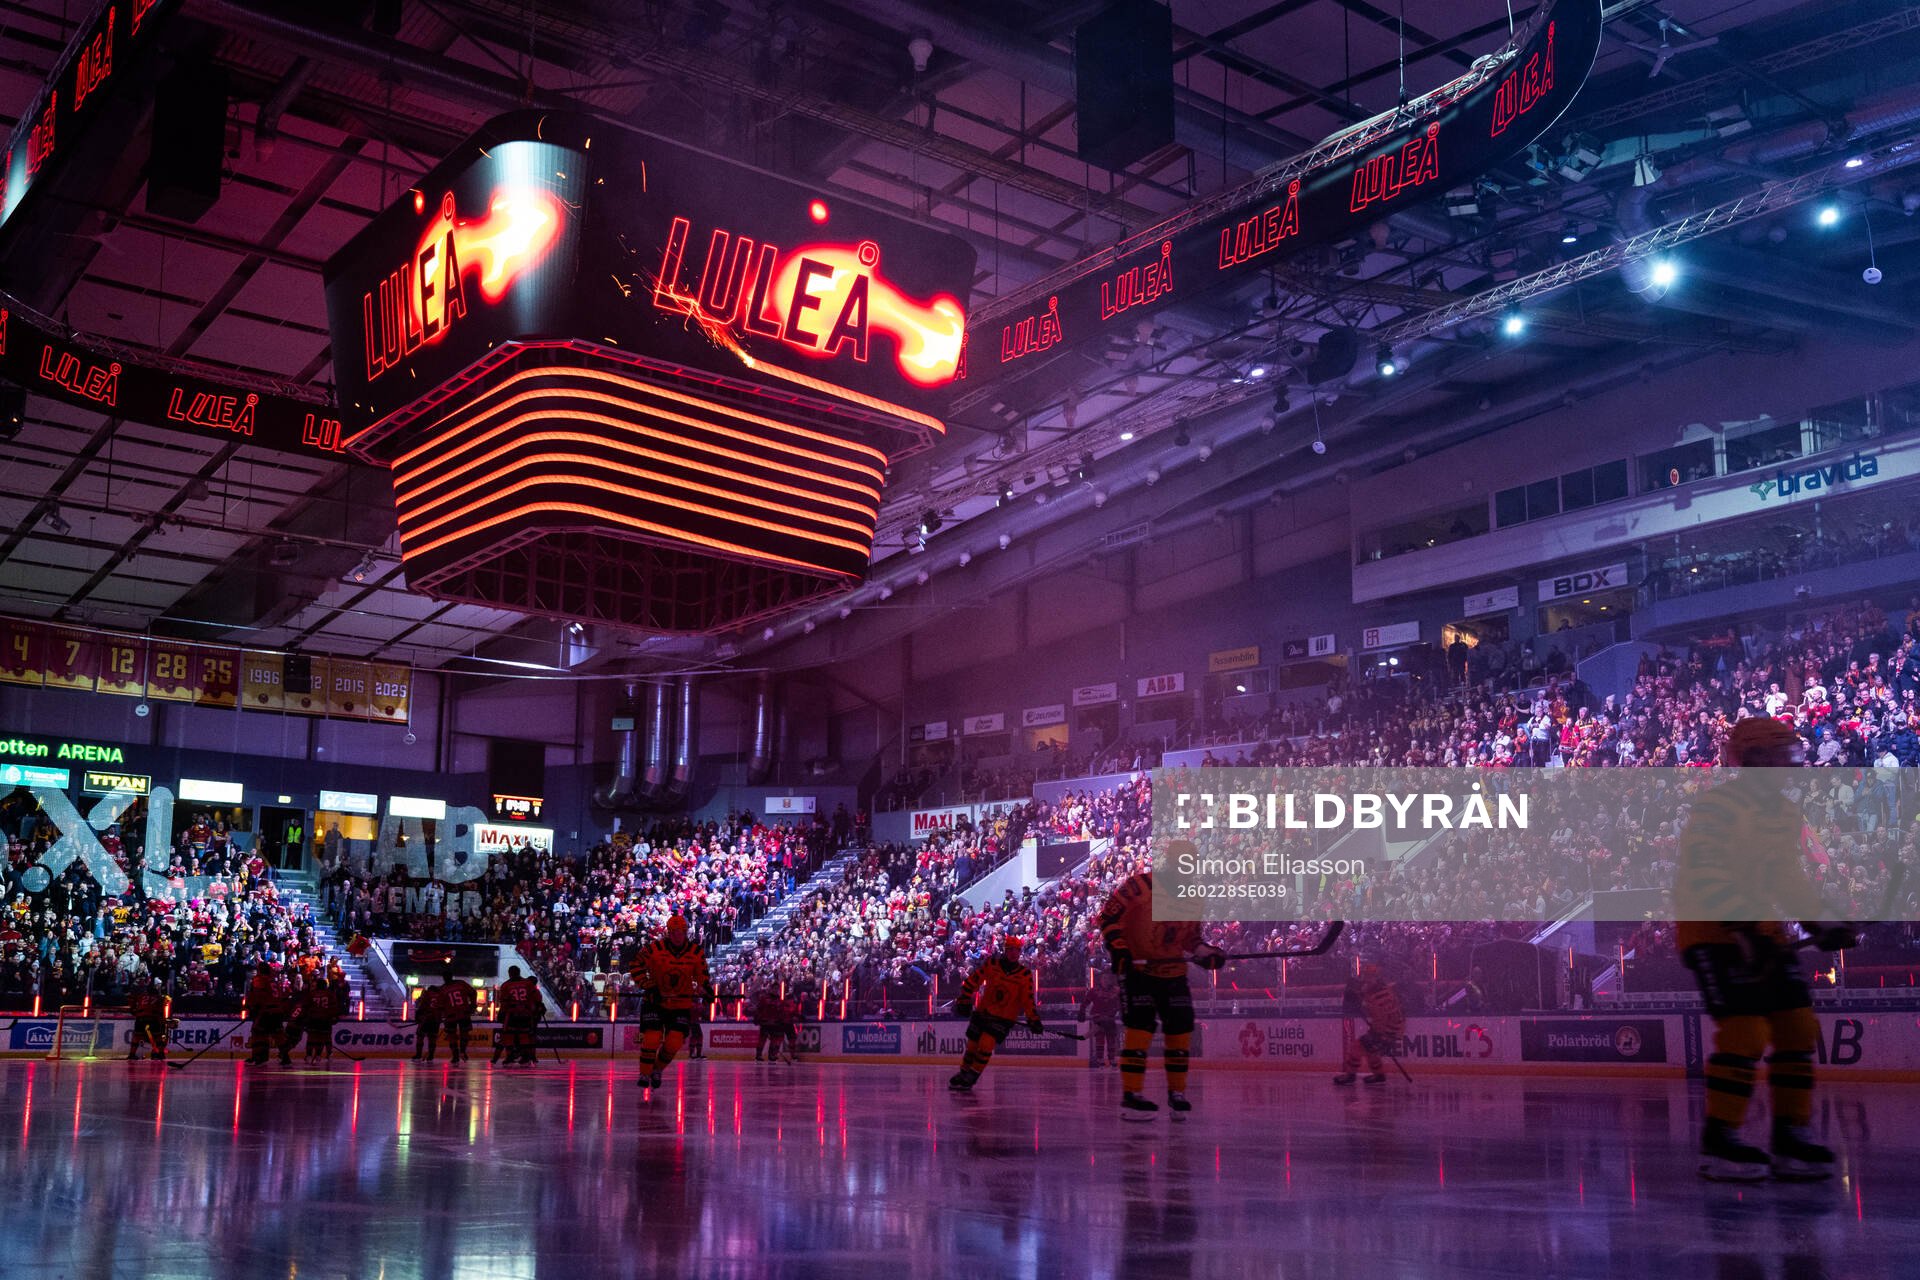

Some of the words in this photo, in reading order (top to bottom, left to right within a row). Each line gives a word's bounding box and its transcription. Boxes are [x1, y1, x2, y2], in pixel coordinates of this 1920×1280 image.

[1351, 121, 1440, 213] LULEÅ
[1219, 179, 1301, 270] LULEÅ
[365, 191, 467, 382] LULEÅ
[653, 217, 881, 363] LULEÅ
[1102, 240, 1173, 321] LULEÅ
[1001, 295, 1063, 364] LULEÅ
[40, 345, 122, 407] LULEÅ
[167, 387, 259, 436] LULEÅ
[302, 413, 347, 453] LUL
[1776, 451, 1878, 497] bravida
[1554, 569, 1610, 596] BDX
[14, 634, 29, 662] 4
[65, 641, 81, 666] 7
[111, 647, 135, 674] 12
[156, 653, 188, 680] 28
[202, 658, 232, 685] 35
[249, 669, 280, 685] 1996
[335, 678, 364, 694] 2015
[375, 682, 407, 698] 2025
[1145, 676, 1176, 695] ABB
[57, 743, 124, 763] ARENA
[89, 773, 147, 789] TITAN
[914, 812, 952, 831] MAXI
[447, 991, 464, 1007] 15
[334, 1028, 415, 1046] Granec
[1268, 1025, 1305, 1039] Luleå
[1547, 1033, 1611, 1048] Polarbröd
[1268, 1042, 1314, 1058] Energi
